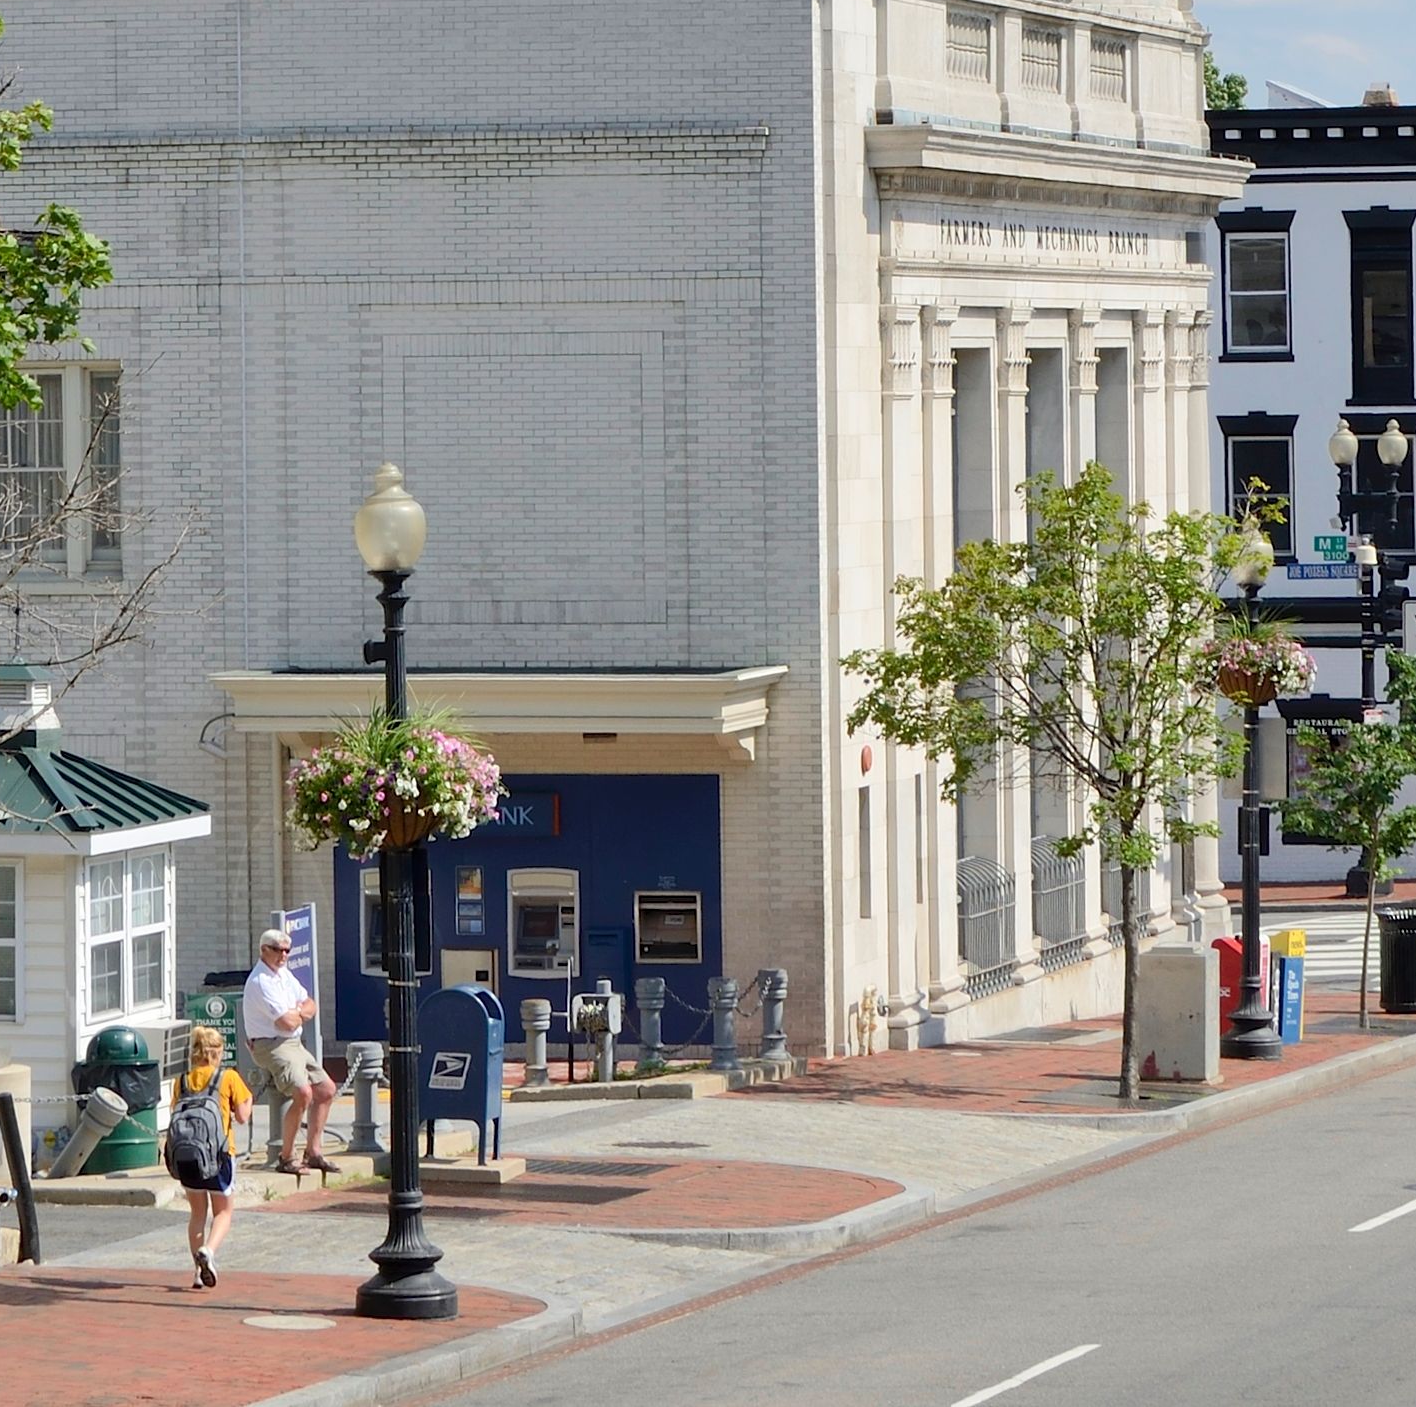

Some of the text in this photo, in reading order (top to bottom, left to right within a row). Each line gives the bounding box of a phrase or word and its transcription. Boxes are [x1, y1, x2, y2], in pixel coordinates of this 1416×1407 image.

[940, 219, 1149, 256] FARMERS AND MECHANICS BRANCH
[1319, 538, 1331, 550] M
[1325, 552, 1349, 560] 3100
[1330, 565, 1358, 578] SQUARE
